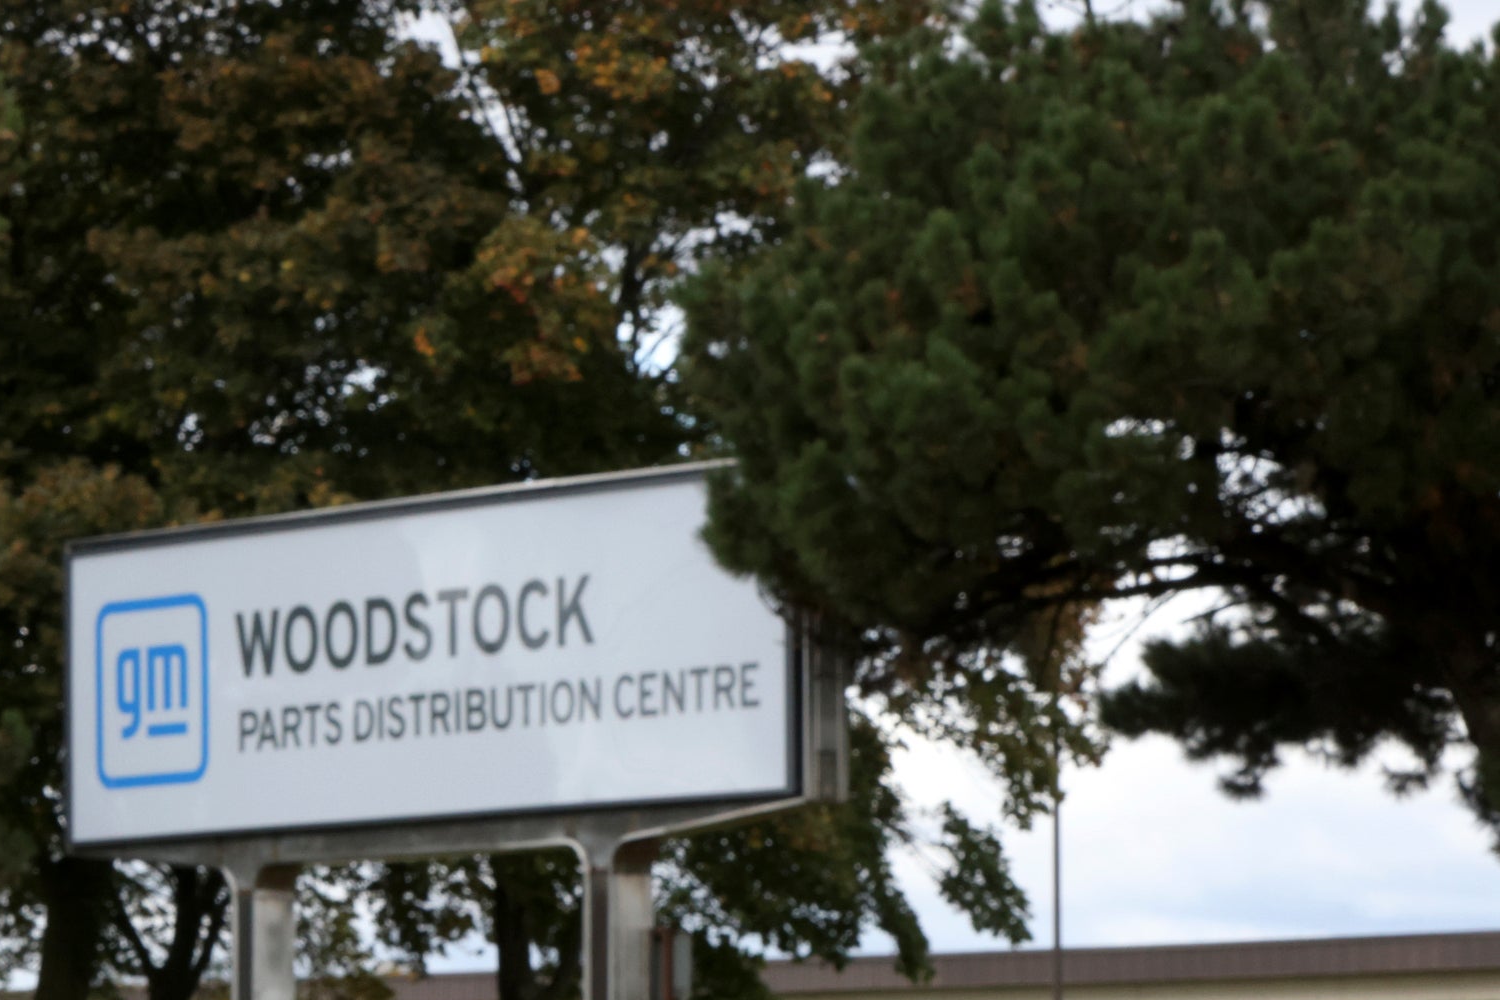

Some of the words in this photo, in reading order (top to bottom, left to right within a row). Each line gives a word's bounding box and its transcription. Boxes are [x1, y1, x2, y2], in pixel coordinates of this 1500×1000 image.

[235, 575, 595, 678] WOODSTOCK
[116, 644, 188, 740] gm
[238, 702, 342, 752] PARTS
[353, 677, 601, 743] DISTRIBUTION
[613, 662, 762, 720] CENTRE
